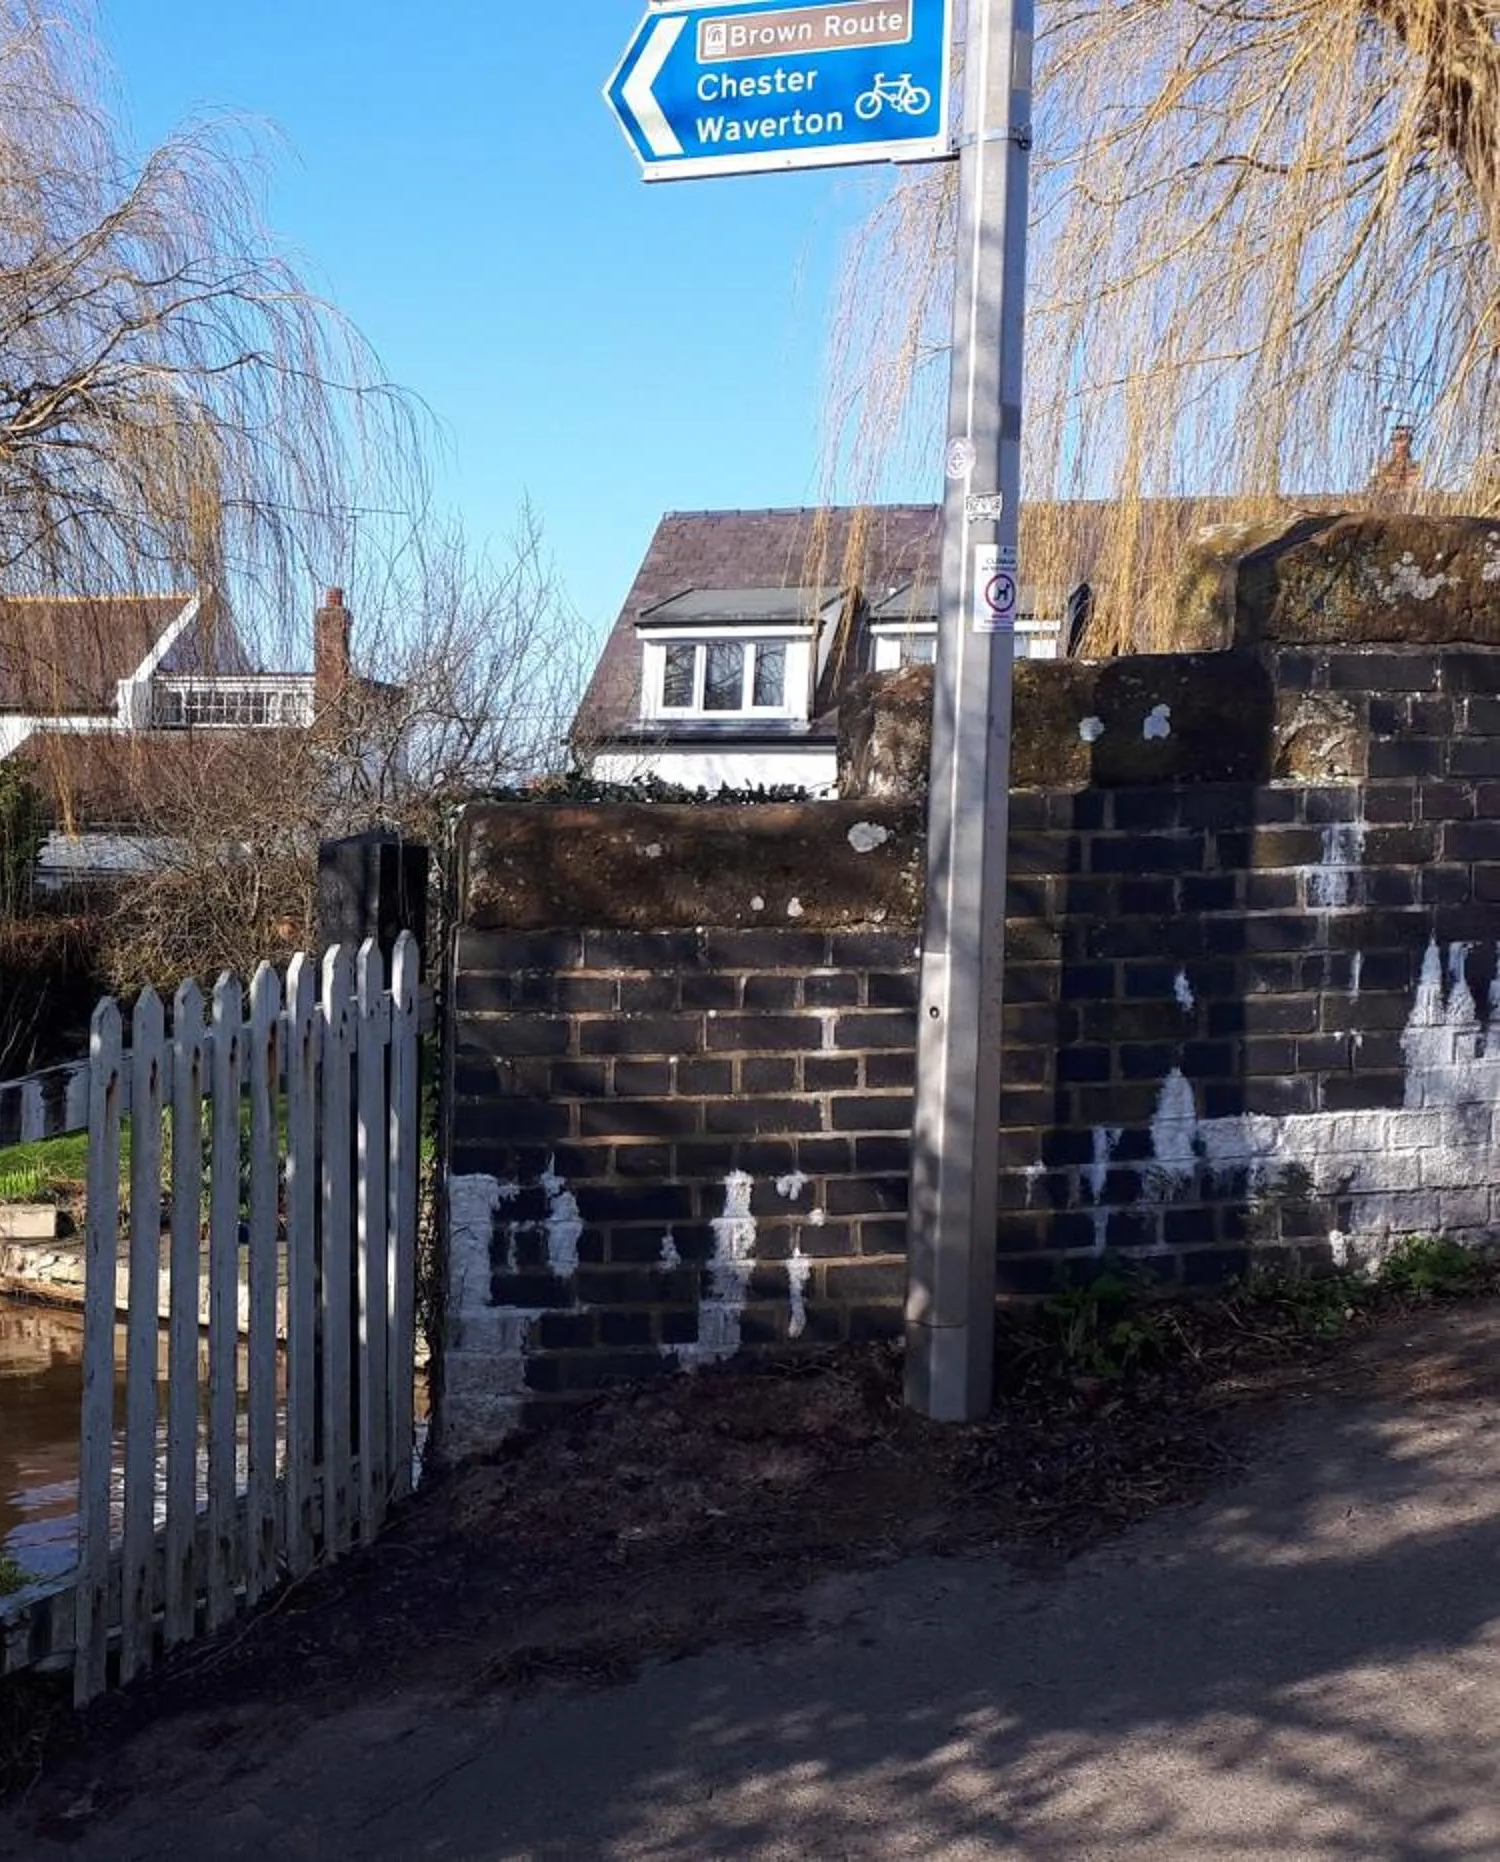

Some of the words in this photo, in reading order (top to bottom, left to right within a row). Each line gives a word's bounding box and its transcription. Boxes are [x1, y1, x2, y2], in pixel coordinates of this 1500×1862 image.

[731, 23, 813, 47] Brown
[825, 11, 903, 37] Route
[697, 68, 818, 101] Chester
[696, 110, 843, 143] Waverton
